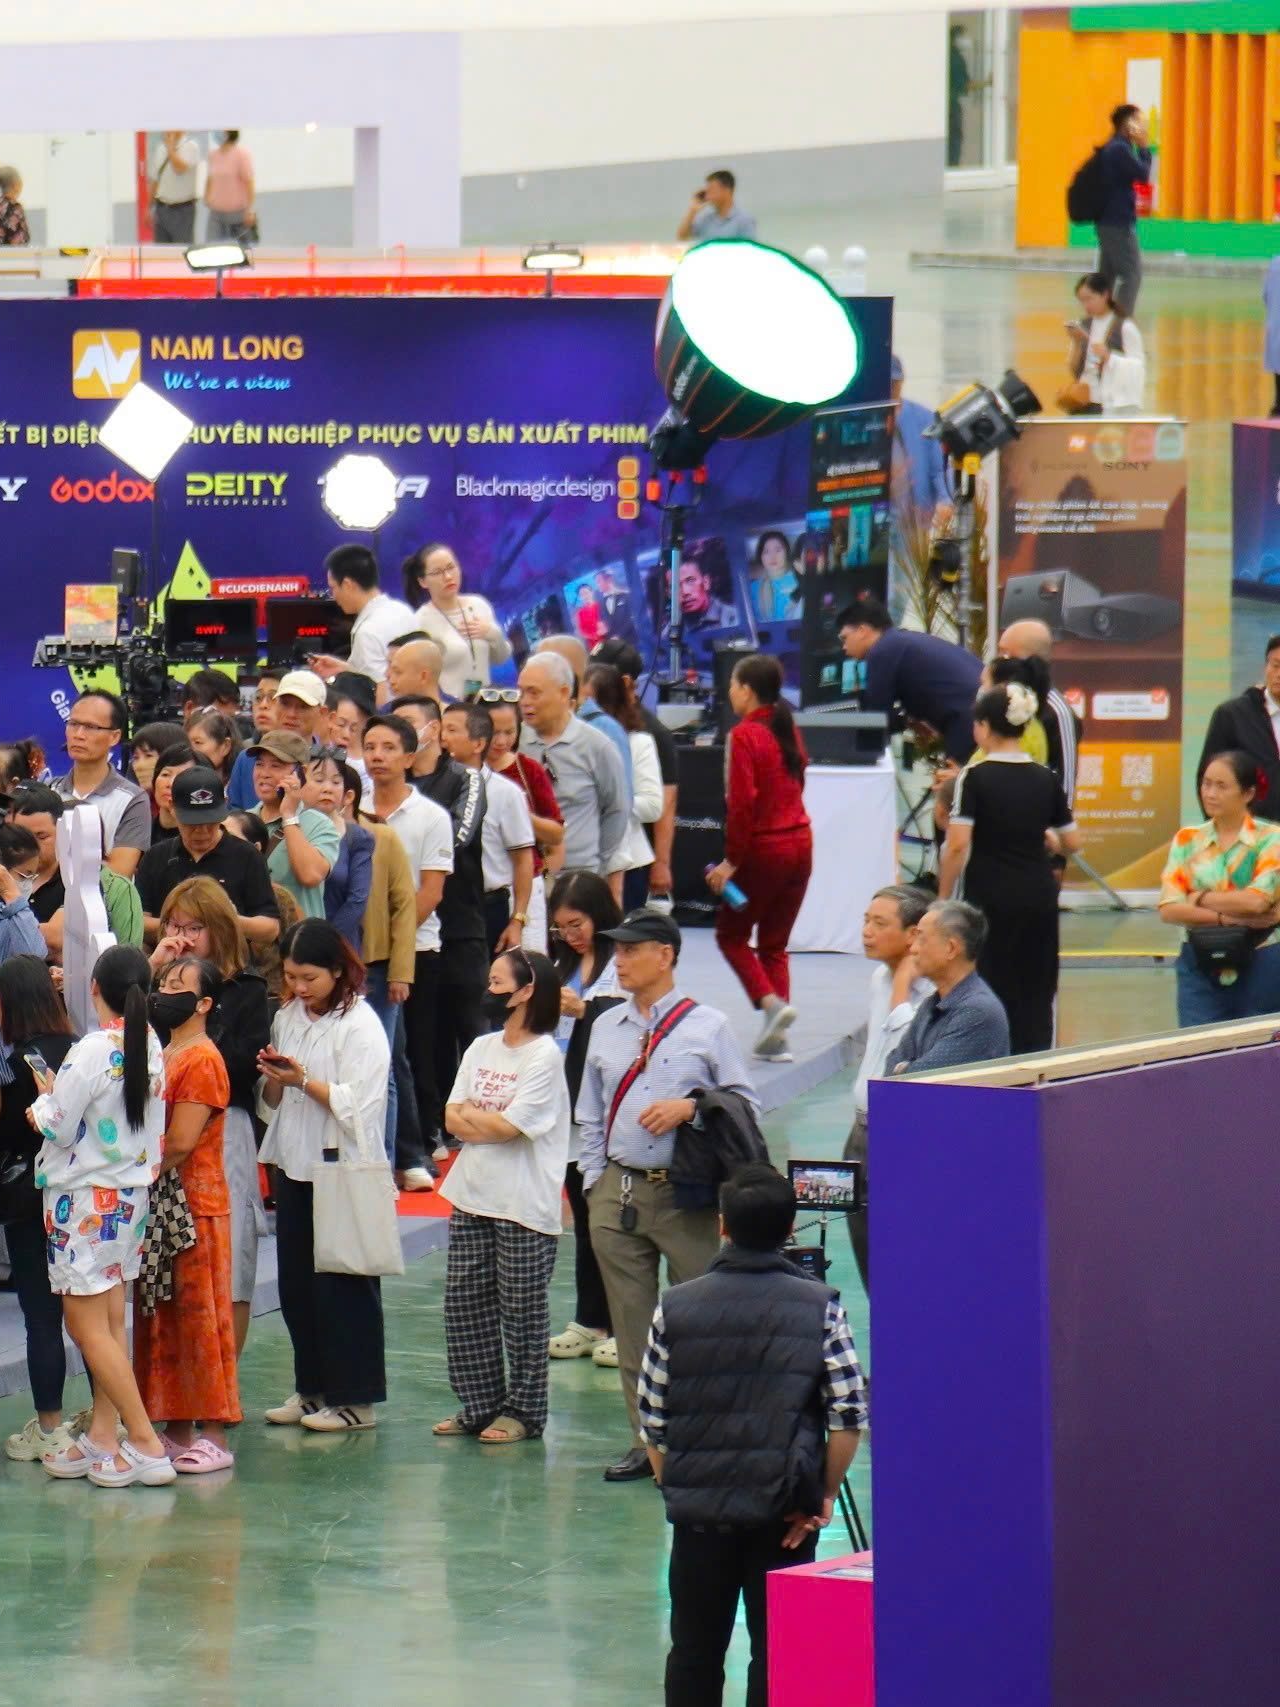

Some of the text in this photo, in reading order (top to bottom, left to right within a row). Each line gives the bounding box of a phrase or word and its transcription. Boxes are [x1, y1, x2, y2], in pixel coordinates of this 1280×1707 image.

[150, 336, 304, 361] NAM LONG
[163, 371, 291, 390] We've a view
[27, 425, 47, 448] BỊ
[183, 420, 262, 445] HUYÊN
[267, 420, 352, 448] NGHIỆP
[358, 424, 421, 447] PHỤC
[427, 424, 460, 447] VỤ
[466, 418, 515, 445] SẢN
[520, 420, 582, 445] XUẤT
[587, 424, 649, 445] PHIM
[1103, 462, 1152, 472] SONY
[50, 470, 155, 503] Godox
[186, 473, 289, 496] DEITY
[455, 475, 616, 502] Blackmagicdesign
[218, 582, 300, 595] #CUCDIENANH
[51, 689, 70, 723] Gia
